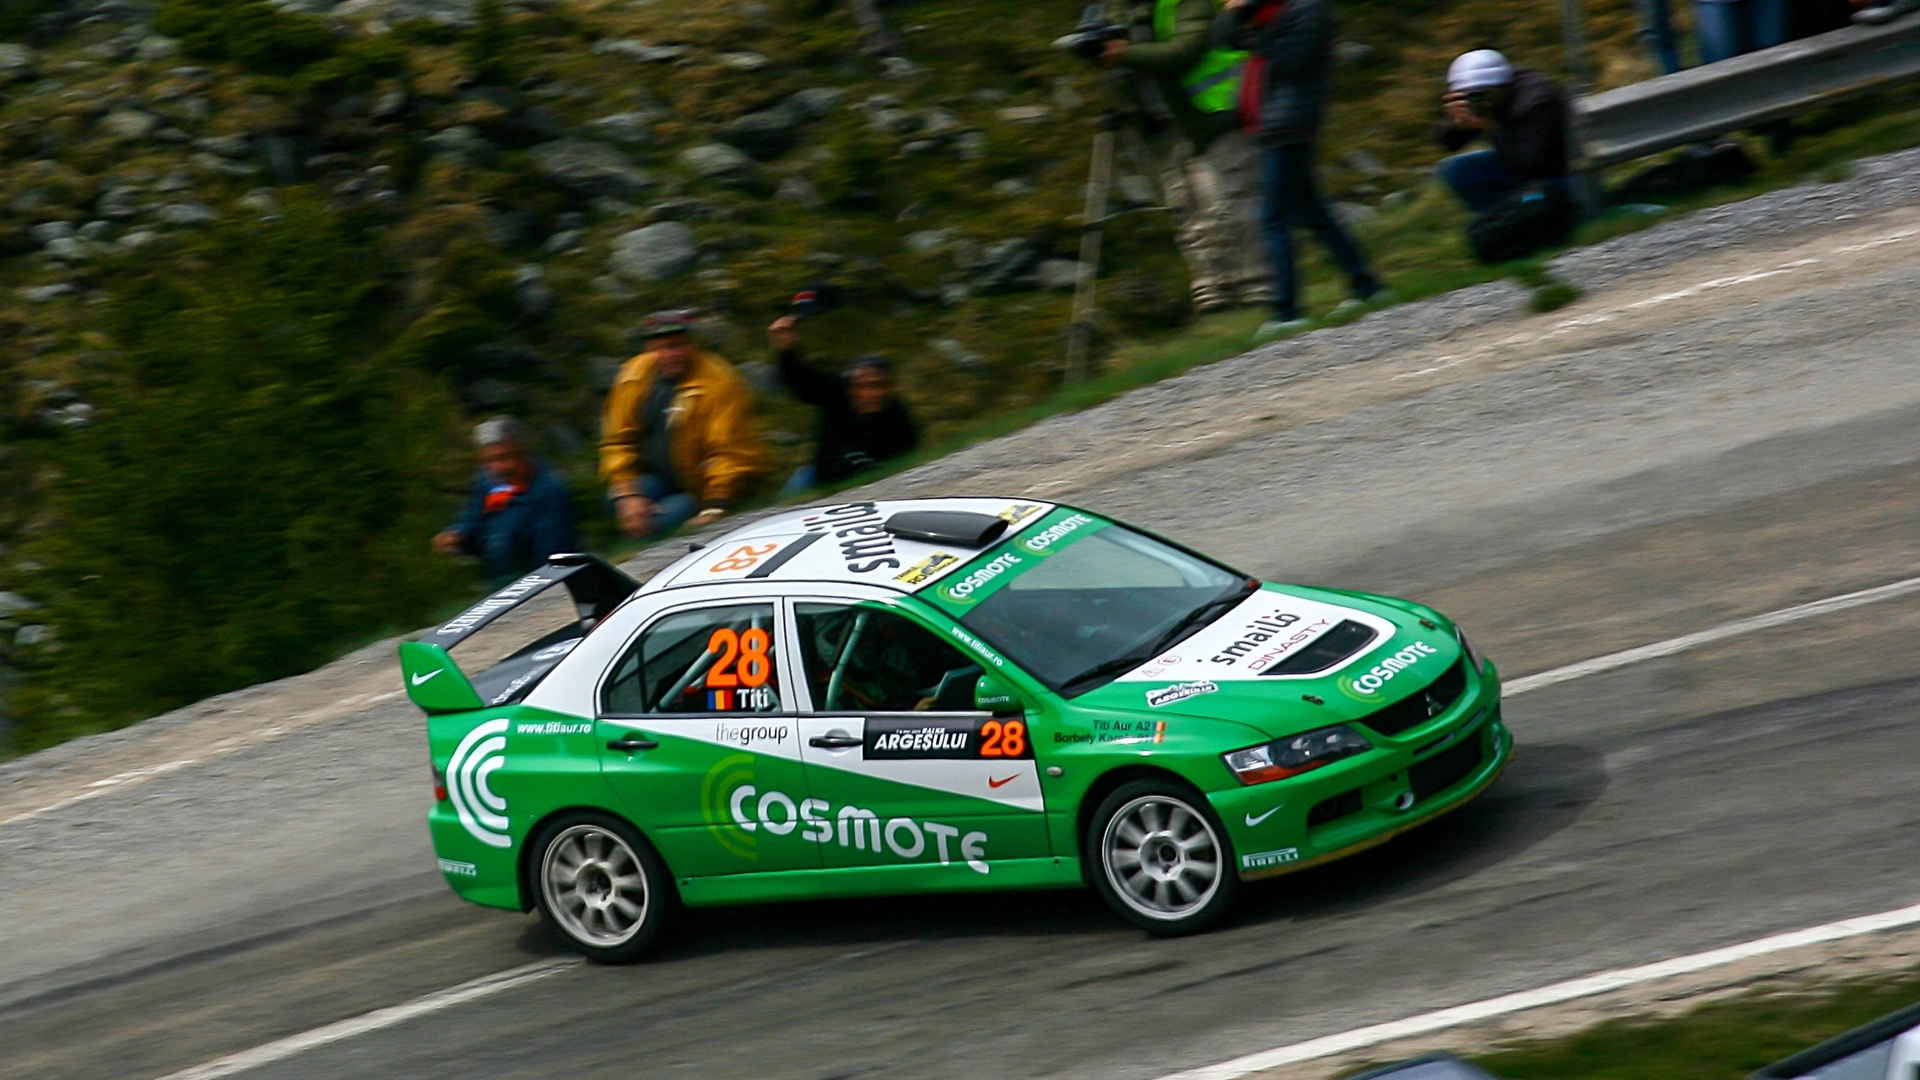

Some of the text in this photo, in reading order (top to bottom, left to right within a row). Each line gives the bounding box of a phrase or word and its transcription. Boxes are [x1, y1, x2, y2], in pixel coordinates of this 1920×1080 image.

[1026, 514, 1093, 550] COSMOTE
[709, 543, 778, 573] 28
[949, 553, 1022, 598] COSMOTE
[706, 627, 771, 688] 28
[951, 626, 1003, 666] www.titiaur.ro
[1248, 619, 1330, 670] DINASTY
[1352, 641, 1437, 694] COSMOTE
[736, 688, 769, 709] Titi
[516, 721, 592, 734] www.titiaur.ro
[980, 719, 1025, 757] 28
[1054, 732, 1096, 745] Borbely
[1093, 719, 1110, 731] Titi
[1112, 719, 1133, 731] Aur
[730, 784, 989, 875] COSMOTE
[1242, 847, 1299, 867] PIRELLI
